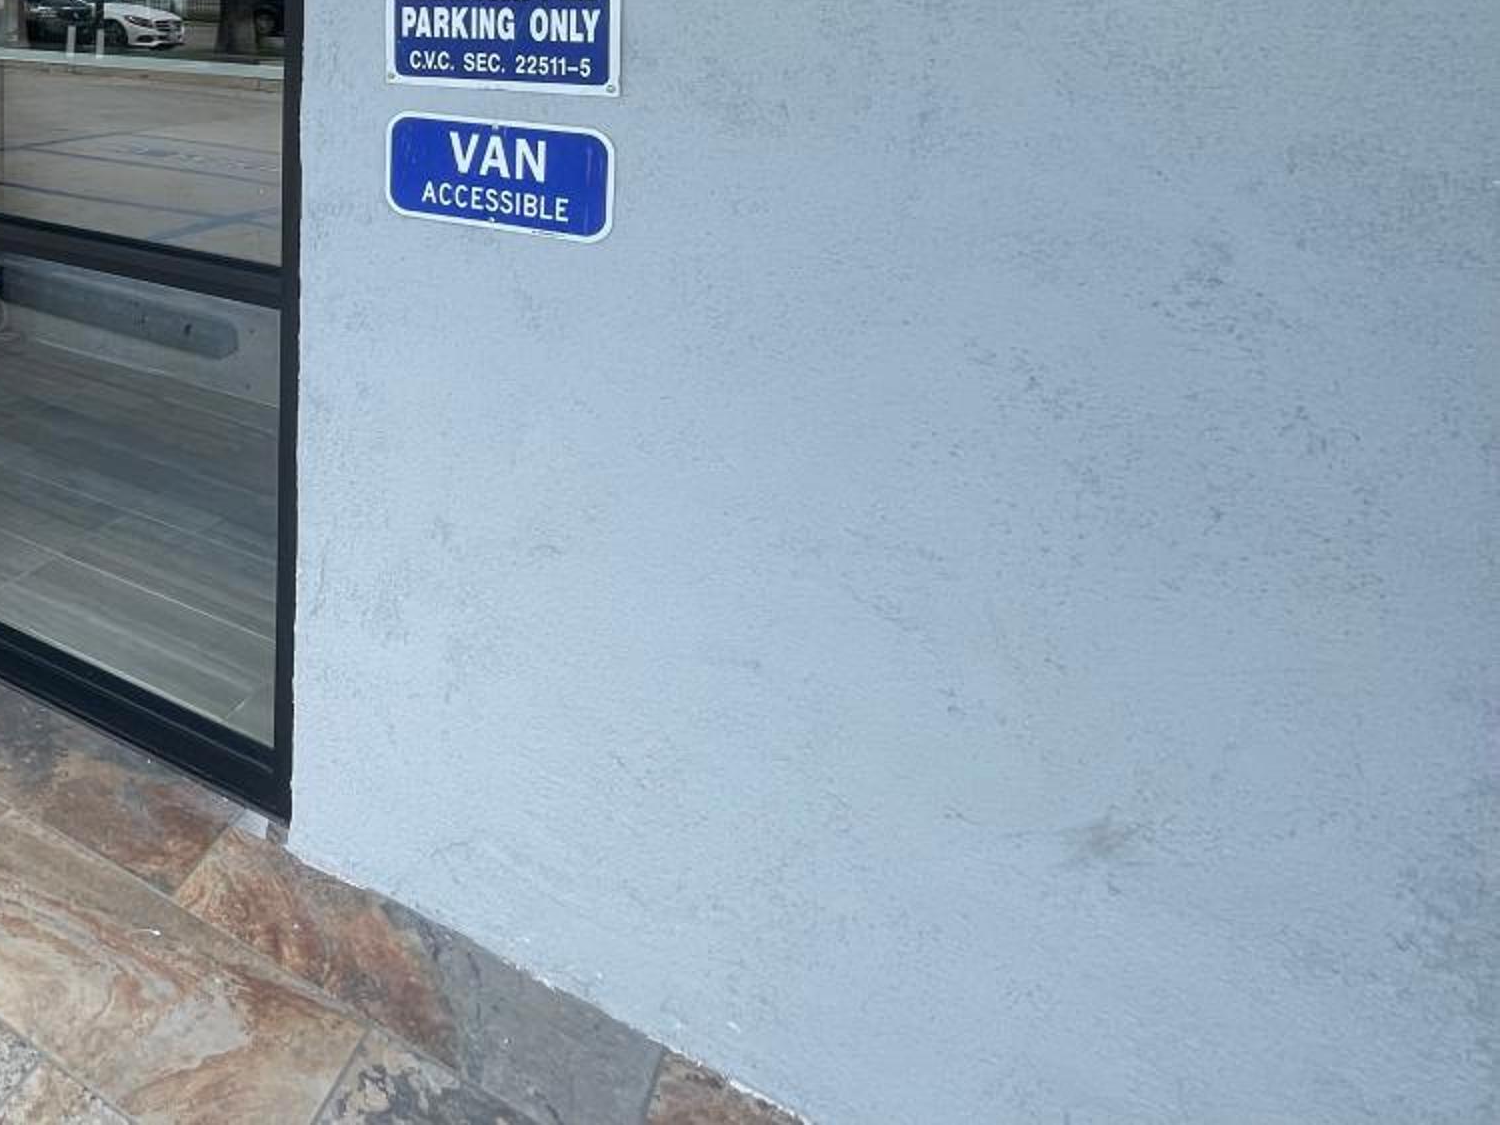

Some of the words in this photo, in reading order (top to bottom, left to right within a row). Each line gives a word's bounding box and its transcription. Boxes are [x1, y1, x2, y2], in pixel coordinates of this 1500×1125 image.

[401, 6, 515, 40] PARKING
[529, 8, 601, 43] ONLY
[409, 50, 454, 70] C.V.C.
[463, 52, 505, 73] SEC.
[515, 55, 591, 77] 22511-5
[449, 131, 547, 183] VAN
[421, 180, 569, 223] ACCESSIBLE
